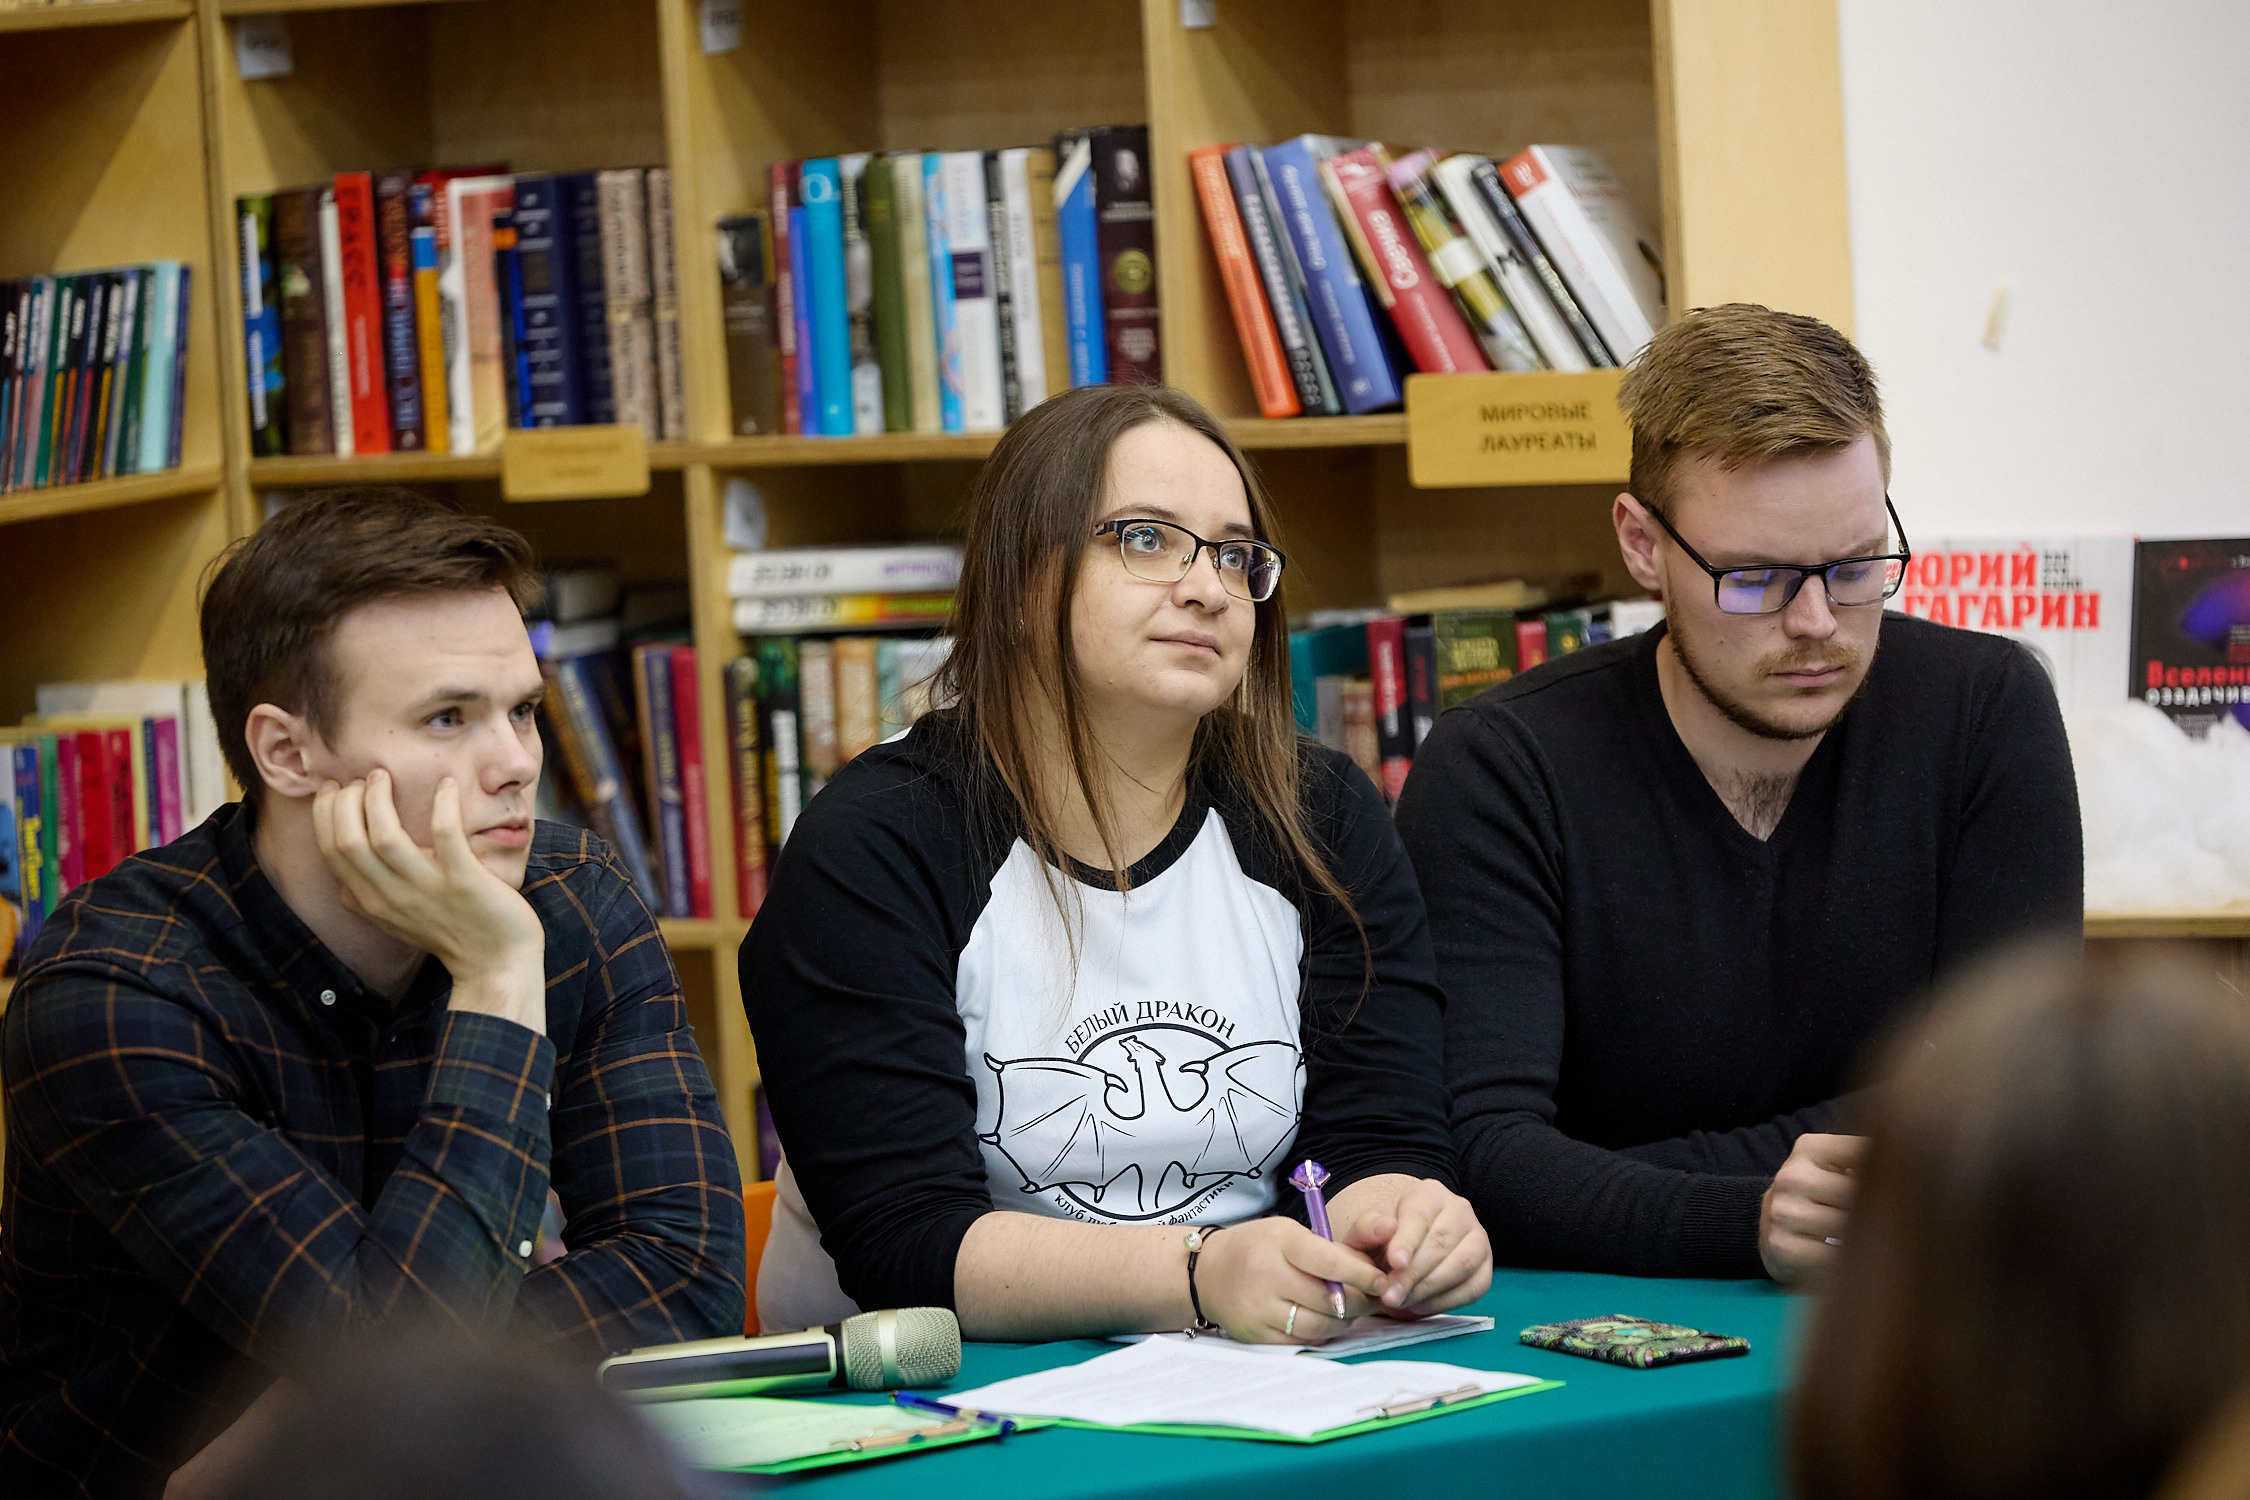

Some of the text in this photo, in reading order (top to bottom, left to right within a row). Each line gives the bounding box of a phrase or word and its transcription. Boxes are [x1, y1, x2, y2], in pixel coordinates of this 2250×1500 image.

[1480, 402, 1588, 421] МИРОВЫЕ
[1480, 432, 1597, 453] ЛАУРЕАТЫ
[1906, 541, 2037, 587] ЮРИЙ
[2146, 660, 2250, 689] Вселен
[1065, 1001, 1235, 1054] БЕЛЫЙ ДРАКОН
[1168, 1181, 1234, 1226] фантастики
